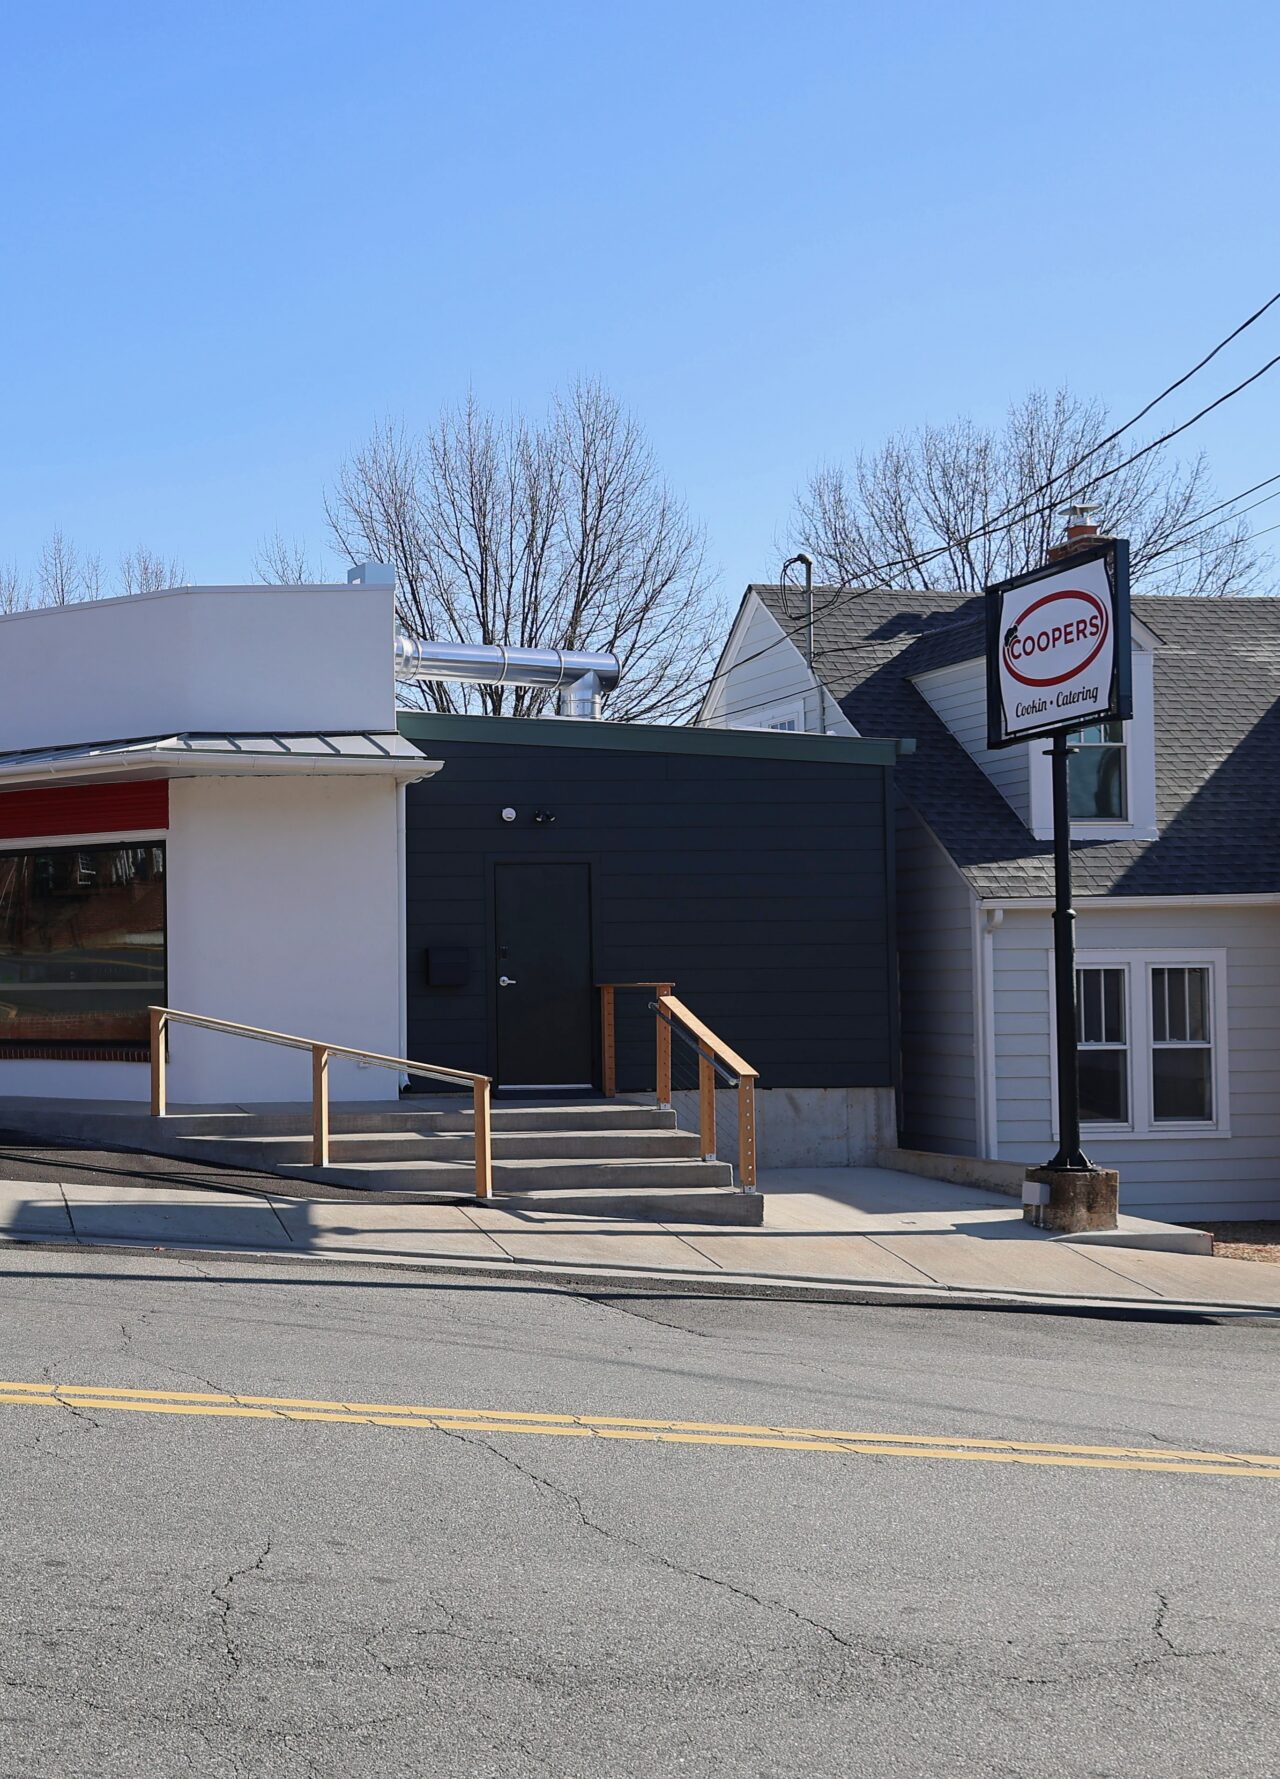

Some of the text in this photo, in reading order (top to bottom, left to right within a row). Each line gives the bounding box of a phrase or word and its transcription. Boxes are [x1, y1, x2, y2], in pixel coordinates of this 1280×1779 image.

[1010, 615, 1100, 660] COOPERS
[1015, 686, 1099, 718] Cookin Catering
